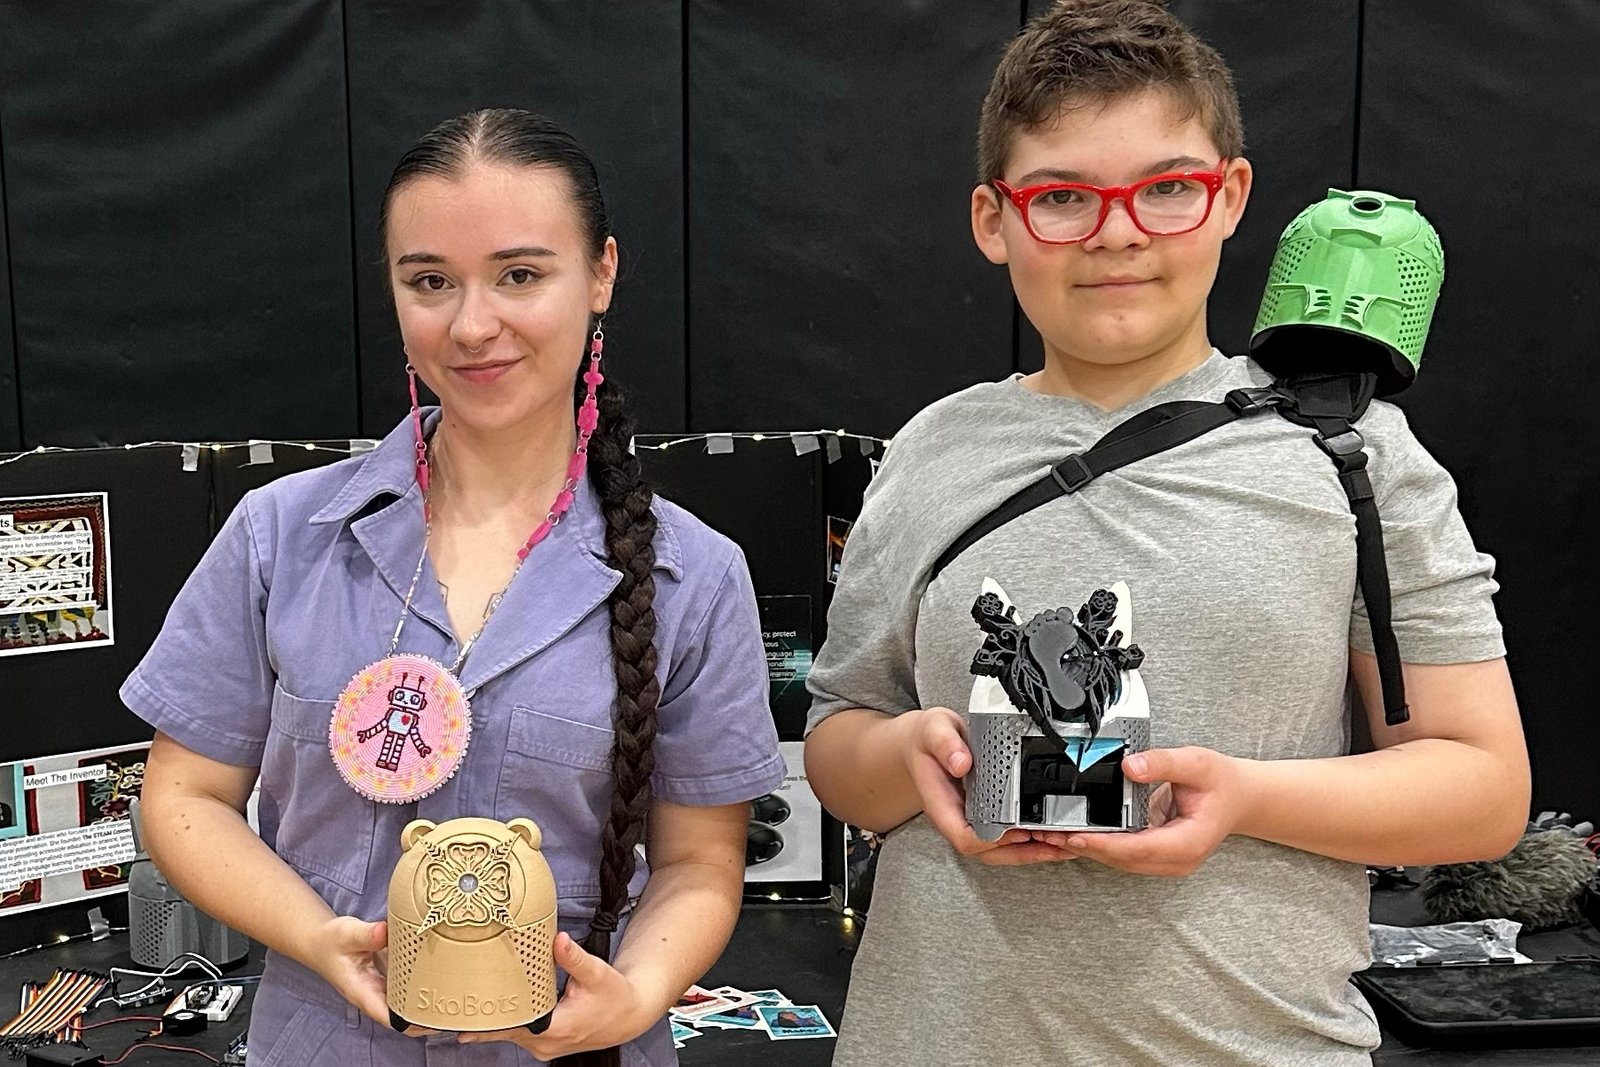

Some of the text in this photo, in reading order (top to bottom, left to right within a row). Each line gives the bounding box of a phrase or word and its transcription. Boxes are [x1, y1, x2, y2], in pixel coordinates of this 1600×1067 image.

[772, 630, 797, 639] protect
[26, 768, 105, 787] Meet The Inventor
[93, 830, 112, 838] STEAM
[417, 987, 519, 1016] SkoBots
